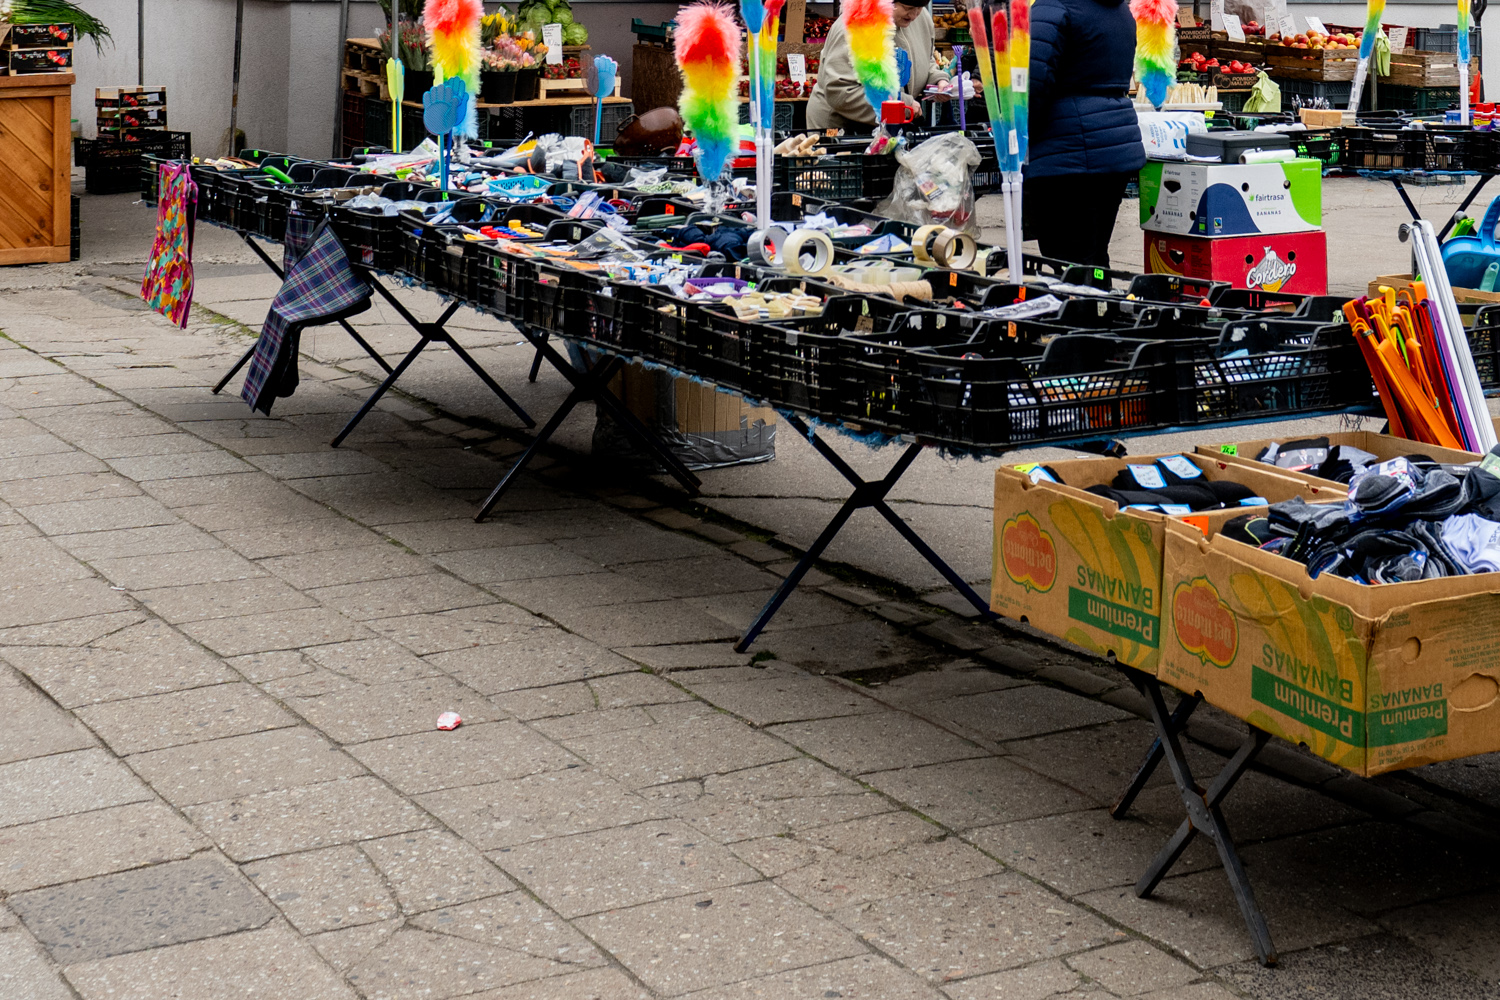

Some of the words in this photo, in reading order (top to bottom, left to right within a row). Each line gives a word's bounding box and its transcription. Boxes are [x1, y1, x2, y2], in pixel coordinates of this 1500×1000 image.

[1180, 33, 1211, 41] MALINOWE
[1181, 28, 1211, 37] POMIDORY
[1231, 75, 1258, 83] POMIDOR
[1255, 193, 1285, 202] fairtrasa
[1162, 210, 1183, 218] BANANAS
[1246, 262, 1297, 289] Cordero
[1076, 565, 1154, 611] BANANAS
[1086, 599, 1154, 642] Premium
[1262, 643, 1354, 704] BANANAS
[1370, 682, 1444, 708] BANANAS
[1275, 682, 1354, 739] Premium
[1381, 706, 1444, 726] Premium
